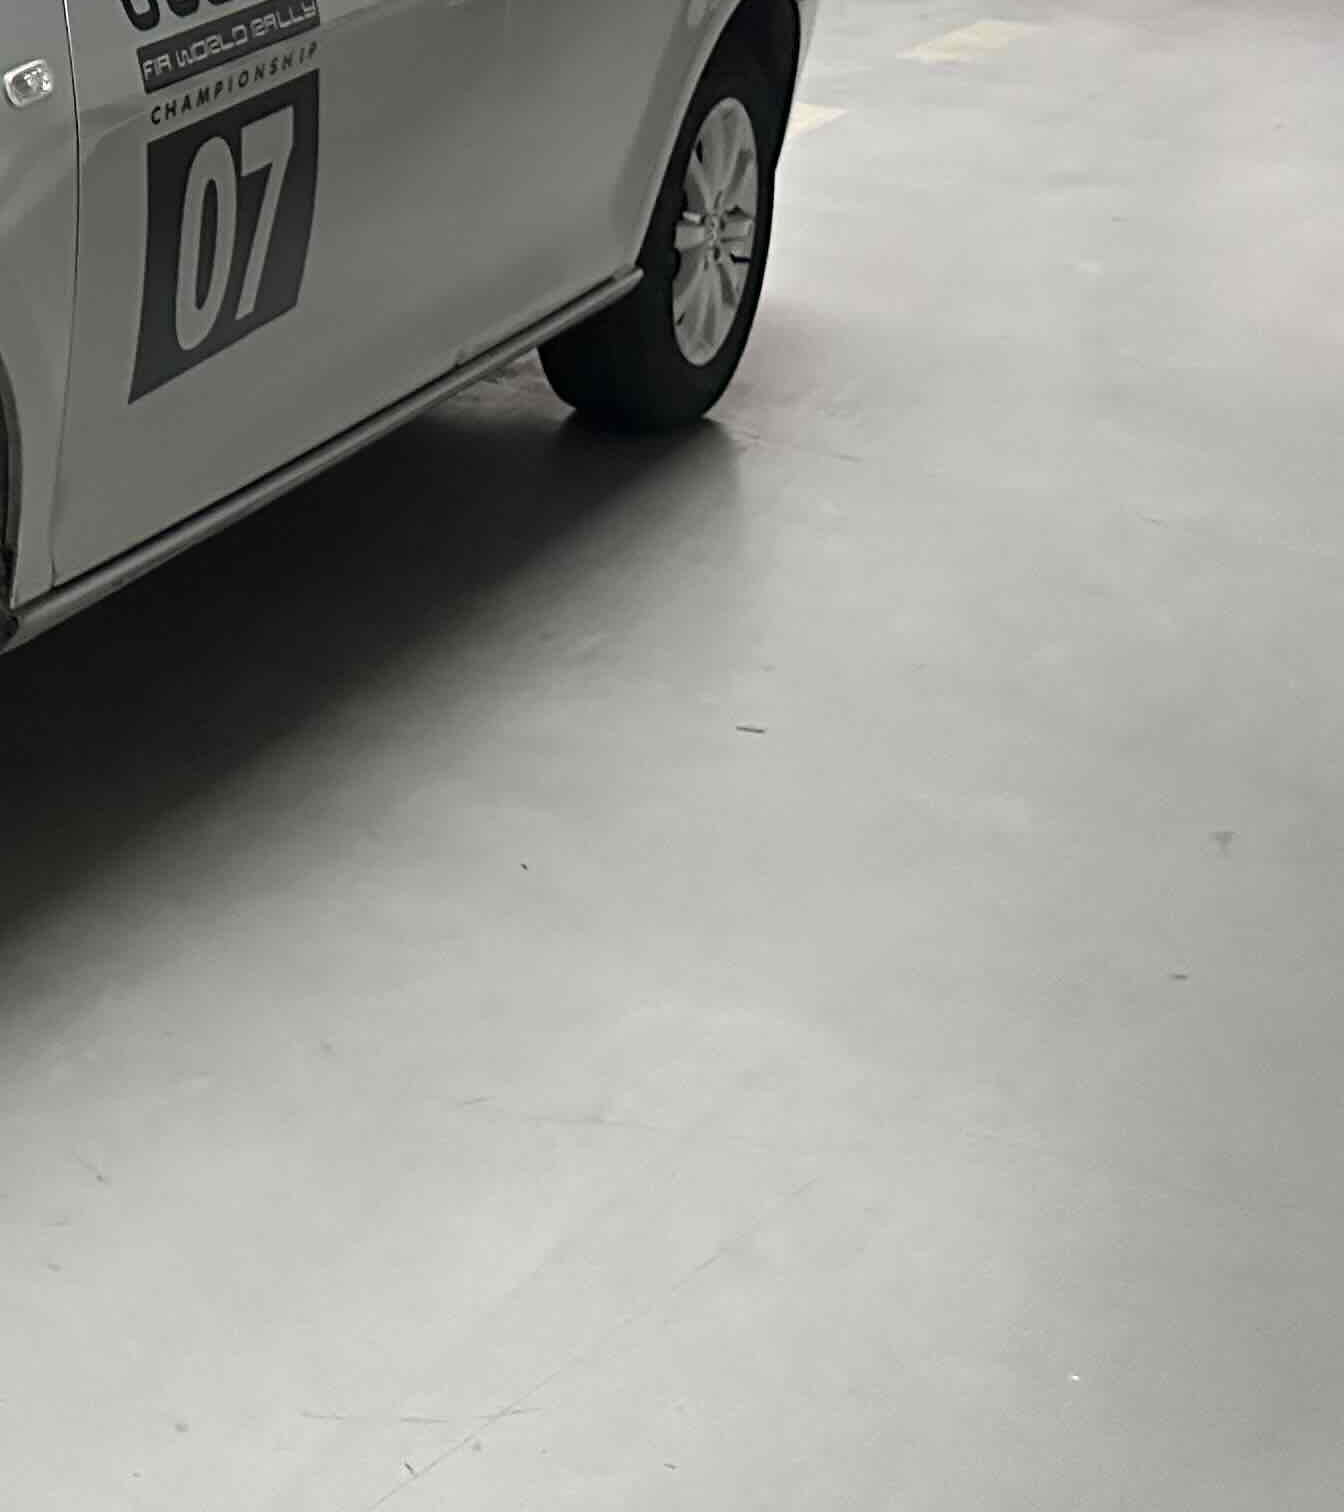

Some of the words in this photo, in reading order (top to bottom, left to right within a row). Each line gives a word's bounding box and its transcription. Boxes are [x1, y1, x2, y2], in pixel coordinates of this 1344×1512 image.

[142, 51, 173, 81] FIA
[175, 23, 249, 70] WORLD
[249, 0, 317, 38] RALLY
[150, 41, 319, 126] CHAMPIONSHIP
[175, 104, 295, 352] 07
